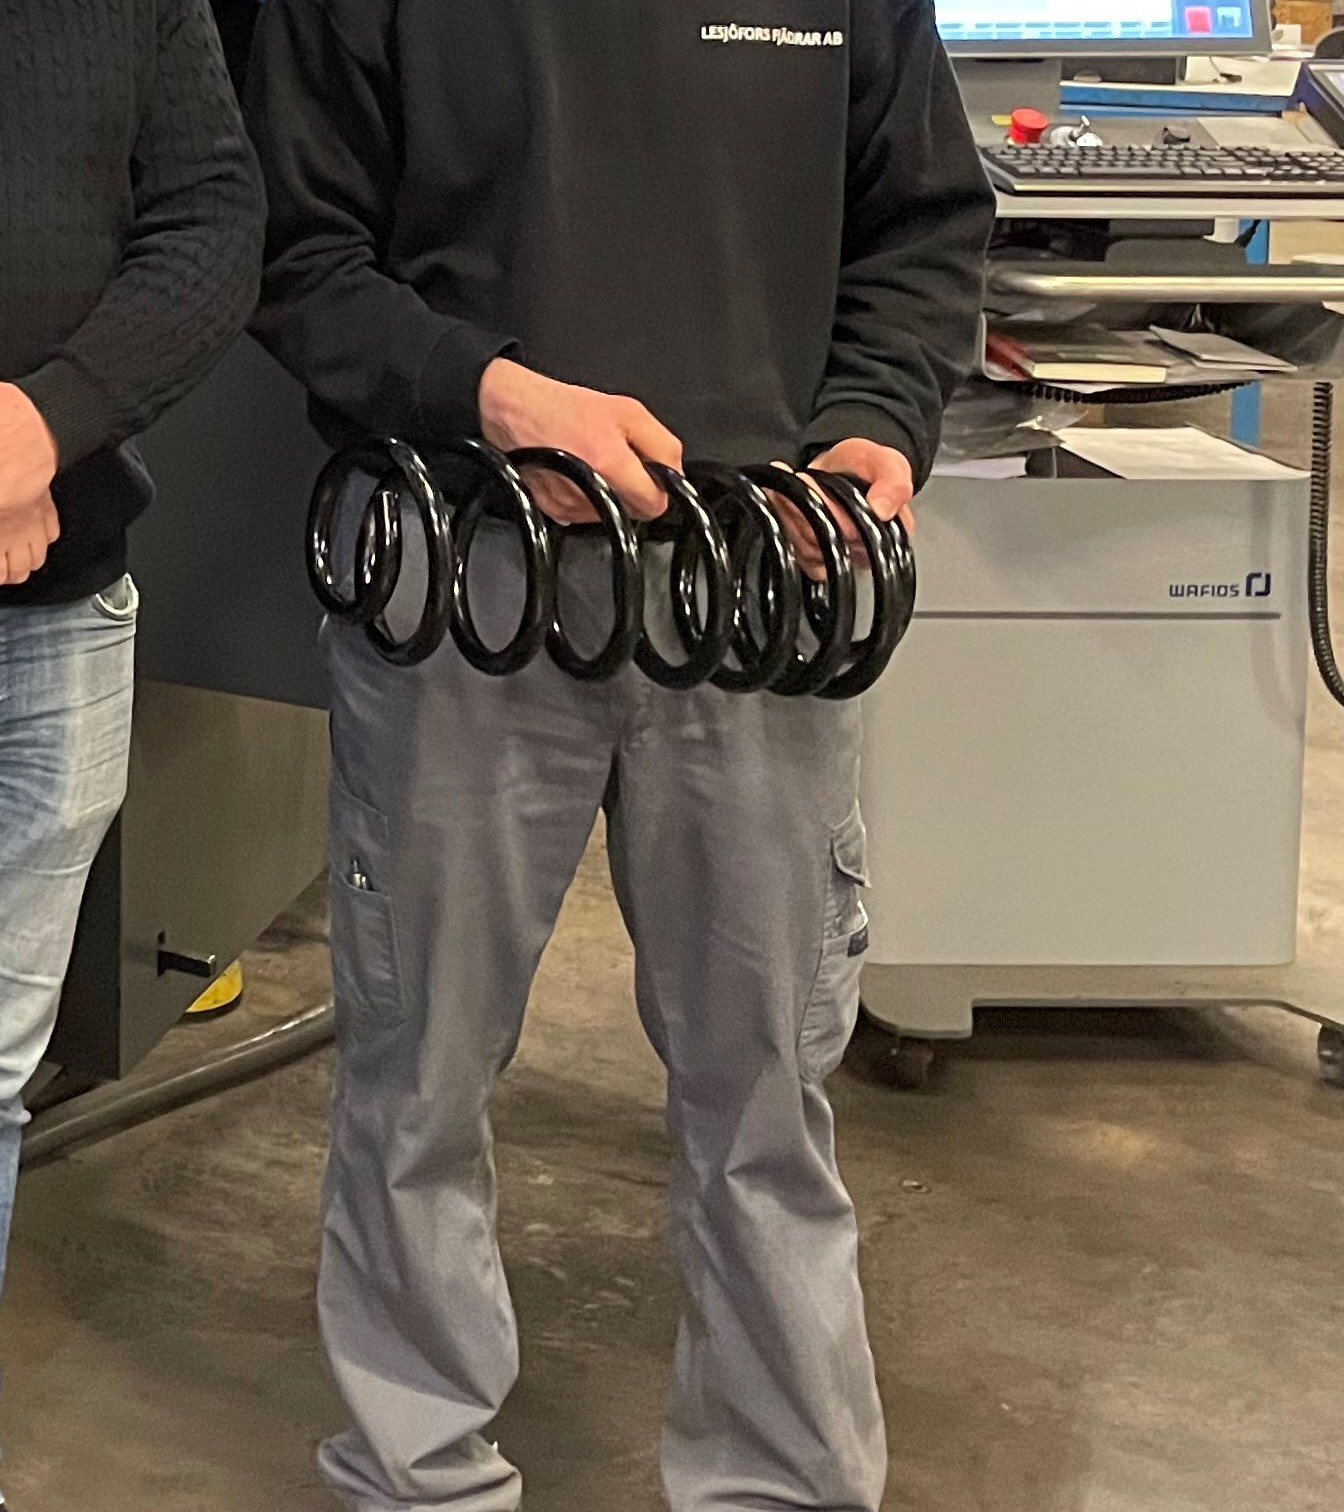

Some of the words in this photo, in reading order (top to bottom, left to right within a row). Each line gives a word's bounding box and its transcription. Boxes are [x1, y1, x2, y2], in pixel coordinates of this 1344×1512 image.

[701, 23, 770, 42] LESJÖFORS
[823, 31, 843, 46] AB
[1169, 584, 1240, 598] WAFIOS
